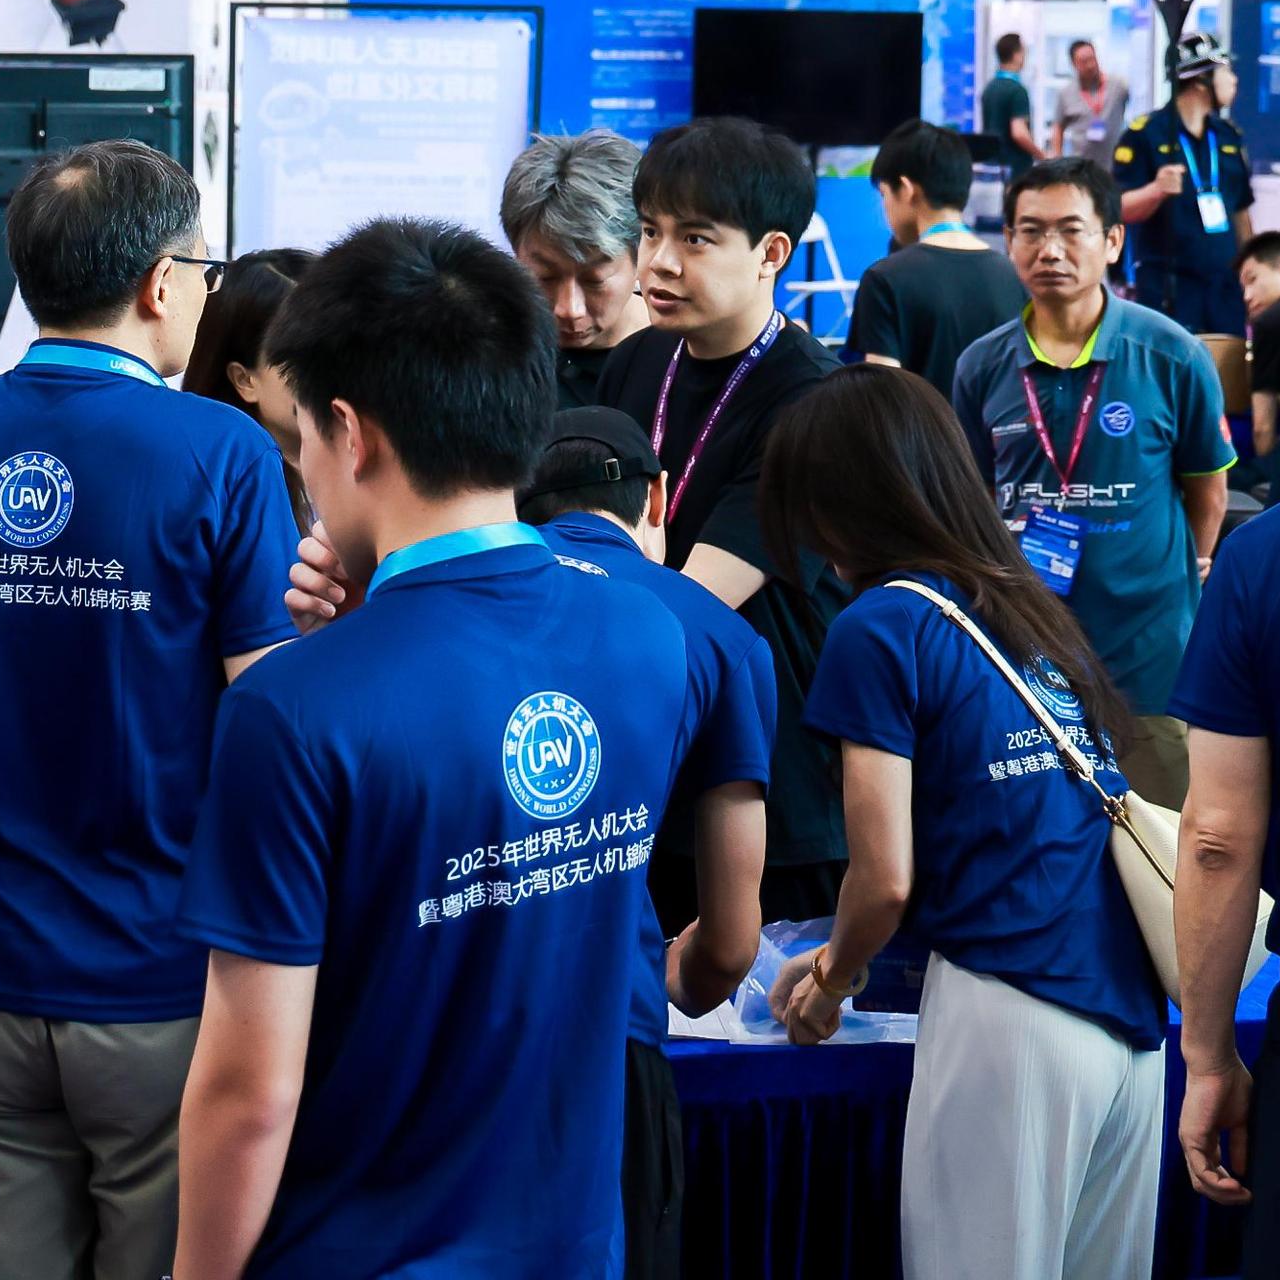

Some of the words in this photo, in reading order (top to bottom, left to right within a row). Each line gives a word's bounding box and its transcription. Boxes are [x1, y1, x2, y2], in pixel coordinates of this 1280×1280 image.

[4, 528, 35, 544] WORLD
[36, 502, 70, 542] CONGRESS
[8, 486, 52, 511] UAV
[505, 695, 594, 757] 世界无人机大会
[508, 767, 533, 807] DRONE
[533, 801, 567, 814] WORLD
[567, 746, 597, 806] CONGRESS
[527, 734, 573, 774] UAV
[445, 802, 649, 881] 2025年世界无人机大会
